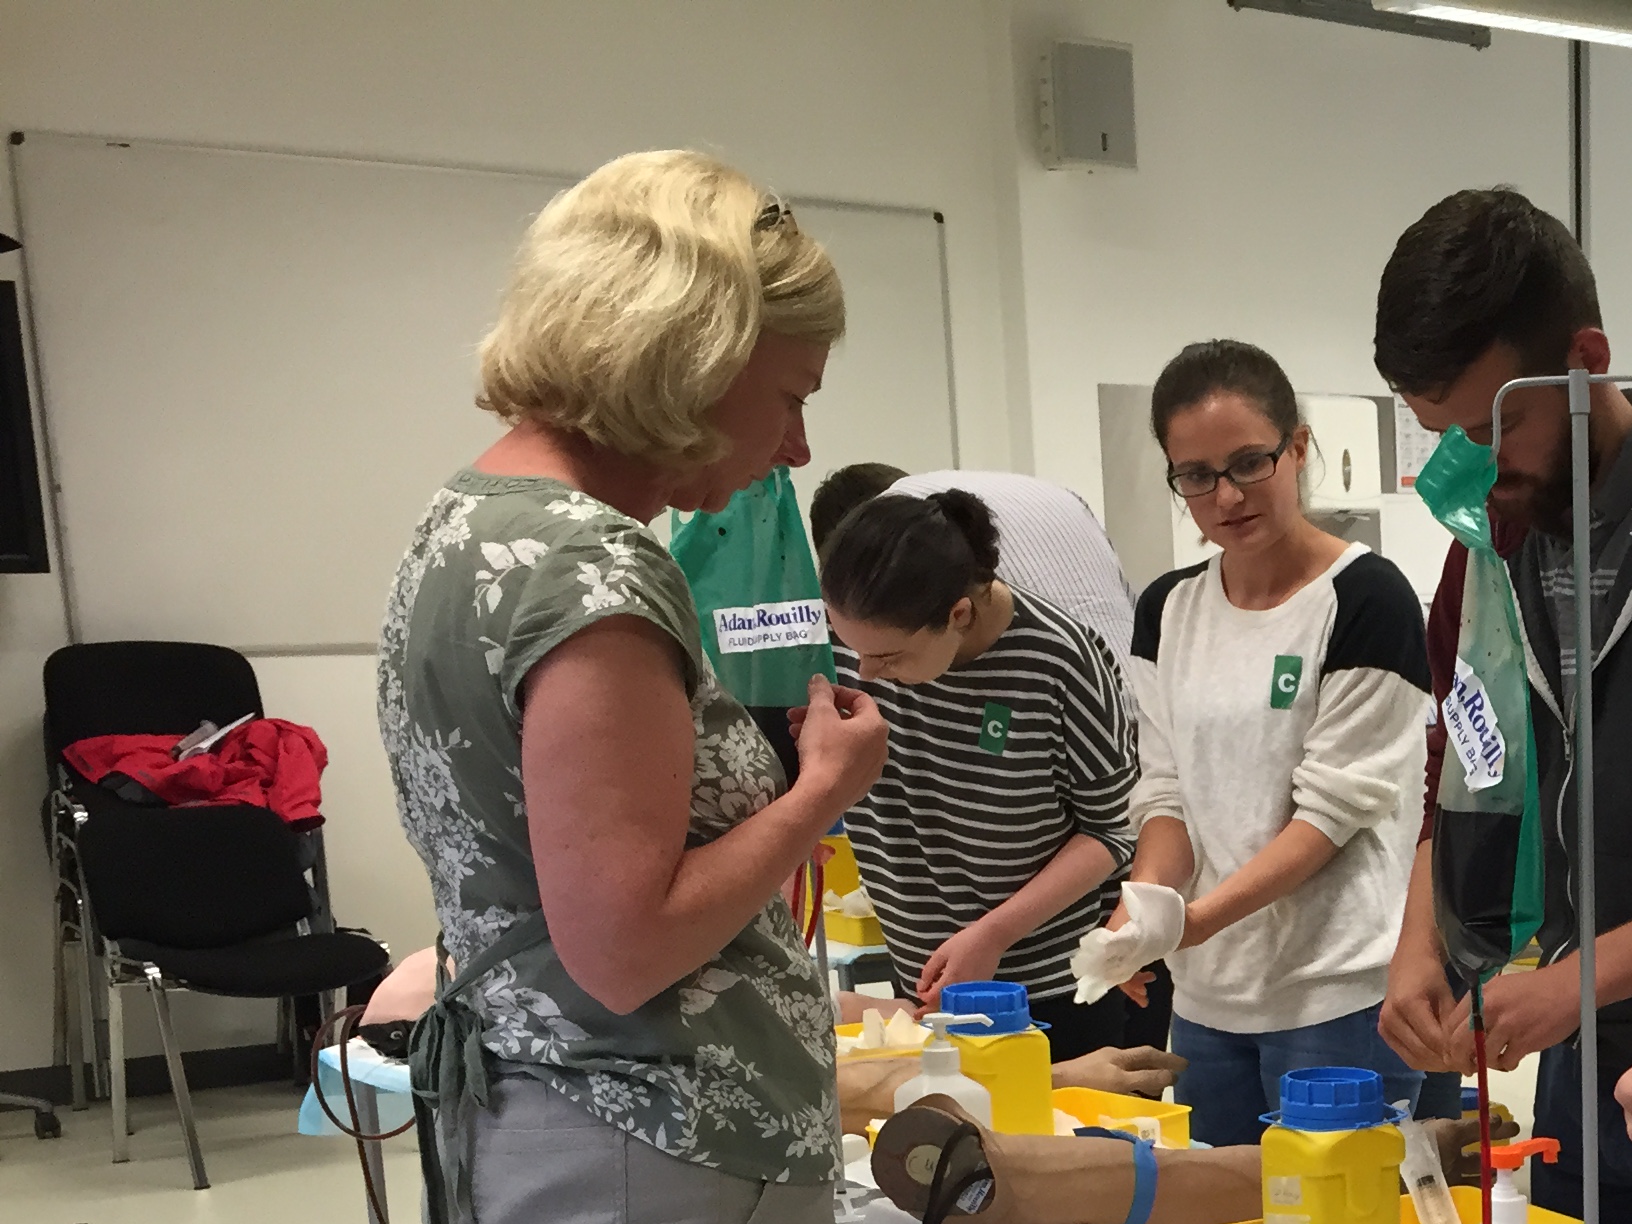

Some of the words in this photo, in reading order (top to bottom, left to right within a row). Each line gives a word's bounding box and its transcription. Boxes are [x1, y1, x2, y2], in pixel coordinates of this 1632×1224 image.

[785, 629, 808, 641] BAG
[1277, 673, 1296, 693] C
[987, 720, 1003, 738] C
[1445, 695, 1470, 746] SUPPLY
